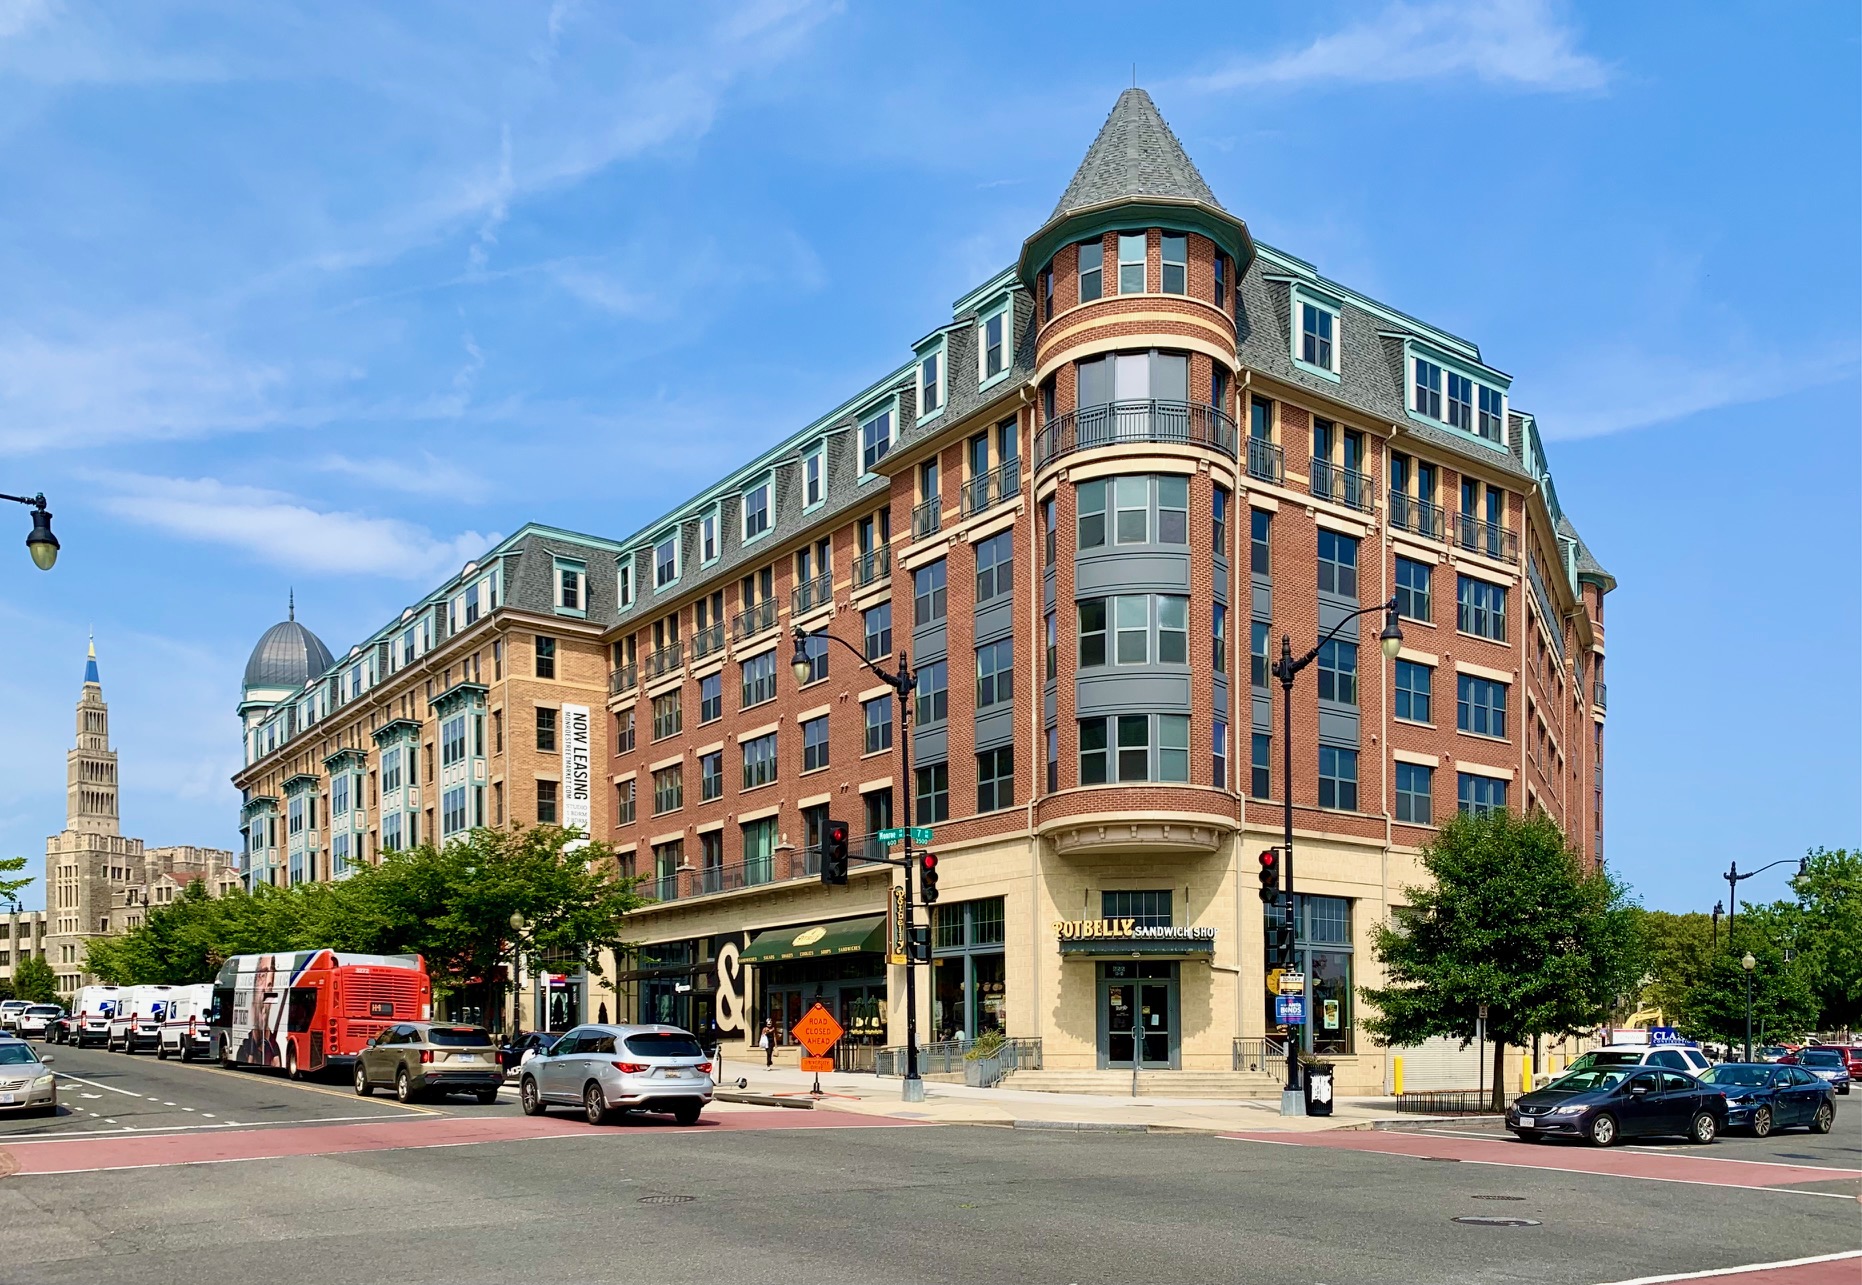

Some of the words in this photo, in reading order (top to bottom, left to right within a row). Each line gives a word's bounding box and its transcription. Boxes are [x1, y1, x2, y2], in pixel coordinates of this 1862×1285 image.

[573, 712, 587, 744] NOW
[573, 748, 588, 800] LEASING
[879, 831, 896, 840] Monroe
[894, 889, 905, 954] Potbelly
[1134, 926, 1189, 938] SANDWICH
[1193, 926, 1219, 938] SHOP
